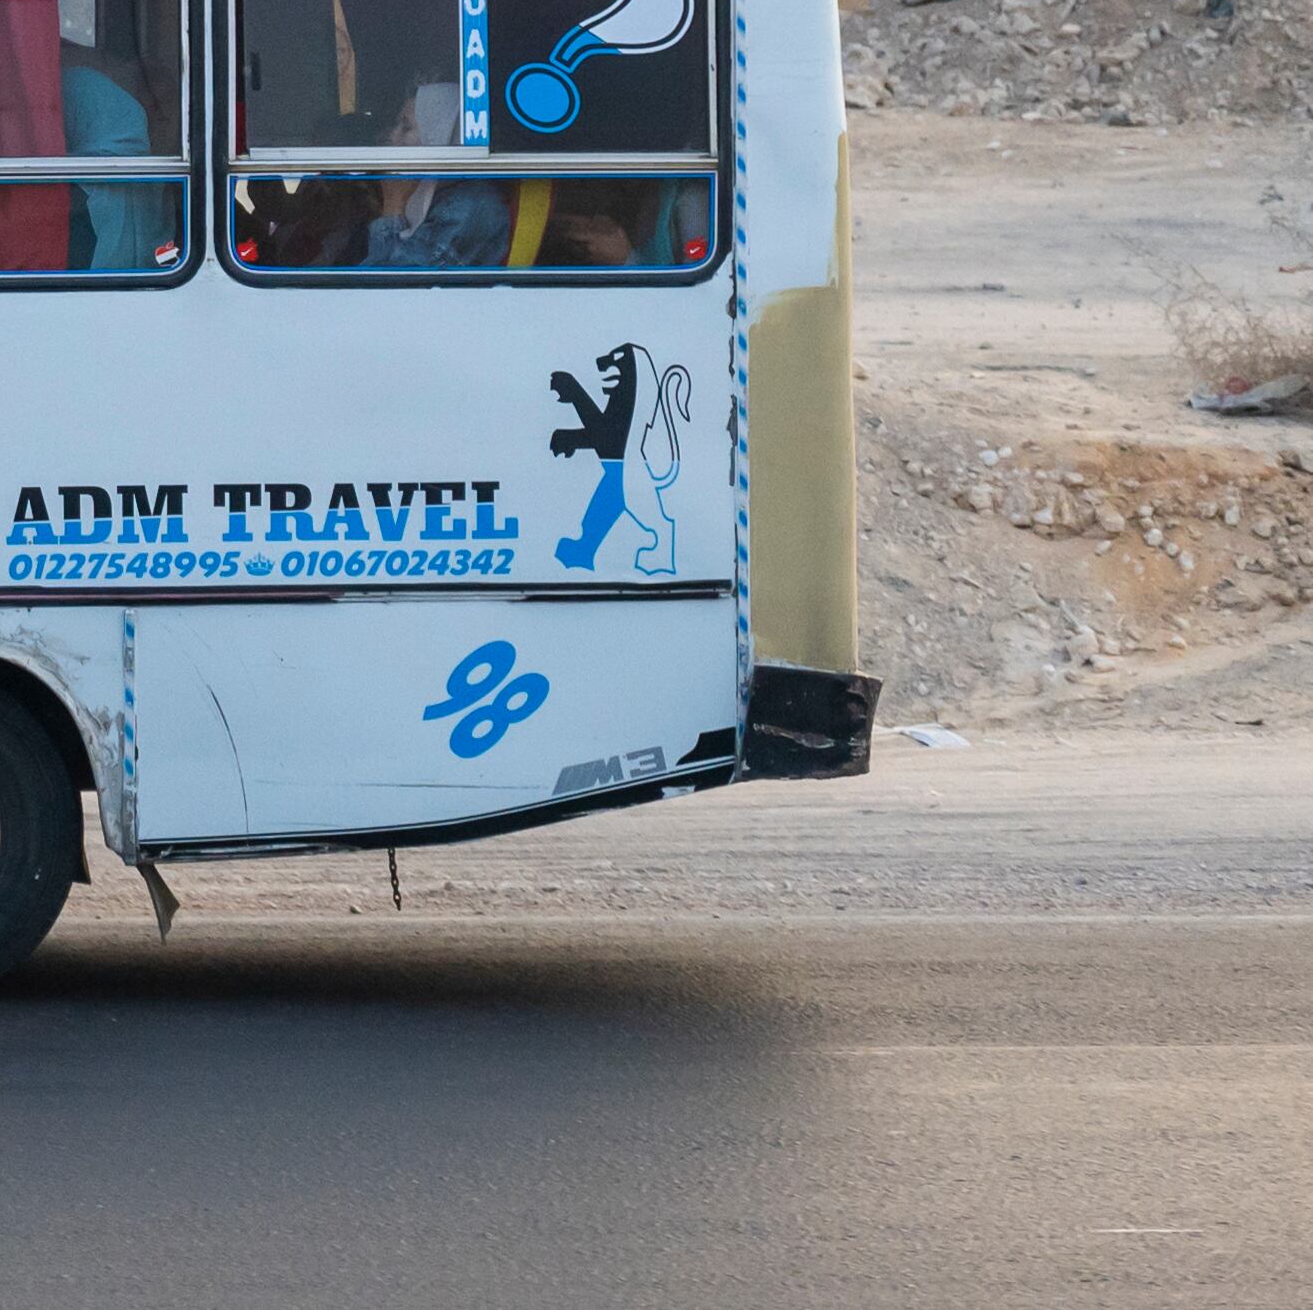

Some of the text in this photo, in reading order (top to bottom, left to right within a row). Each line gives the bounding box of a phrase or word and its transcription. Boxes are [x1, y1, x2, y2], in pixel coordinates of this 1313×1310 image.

[6, 480, 520, 546] ADM TRAVEL
[8, 547, 515, 581] 01227548995 01067024342
